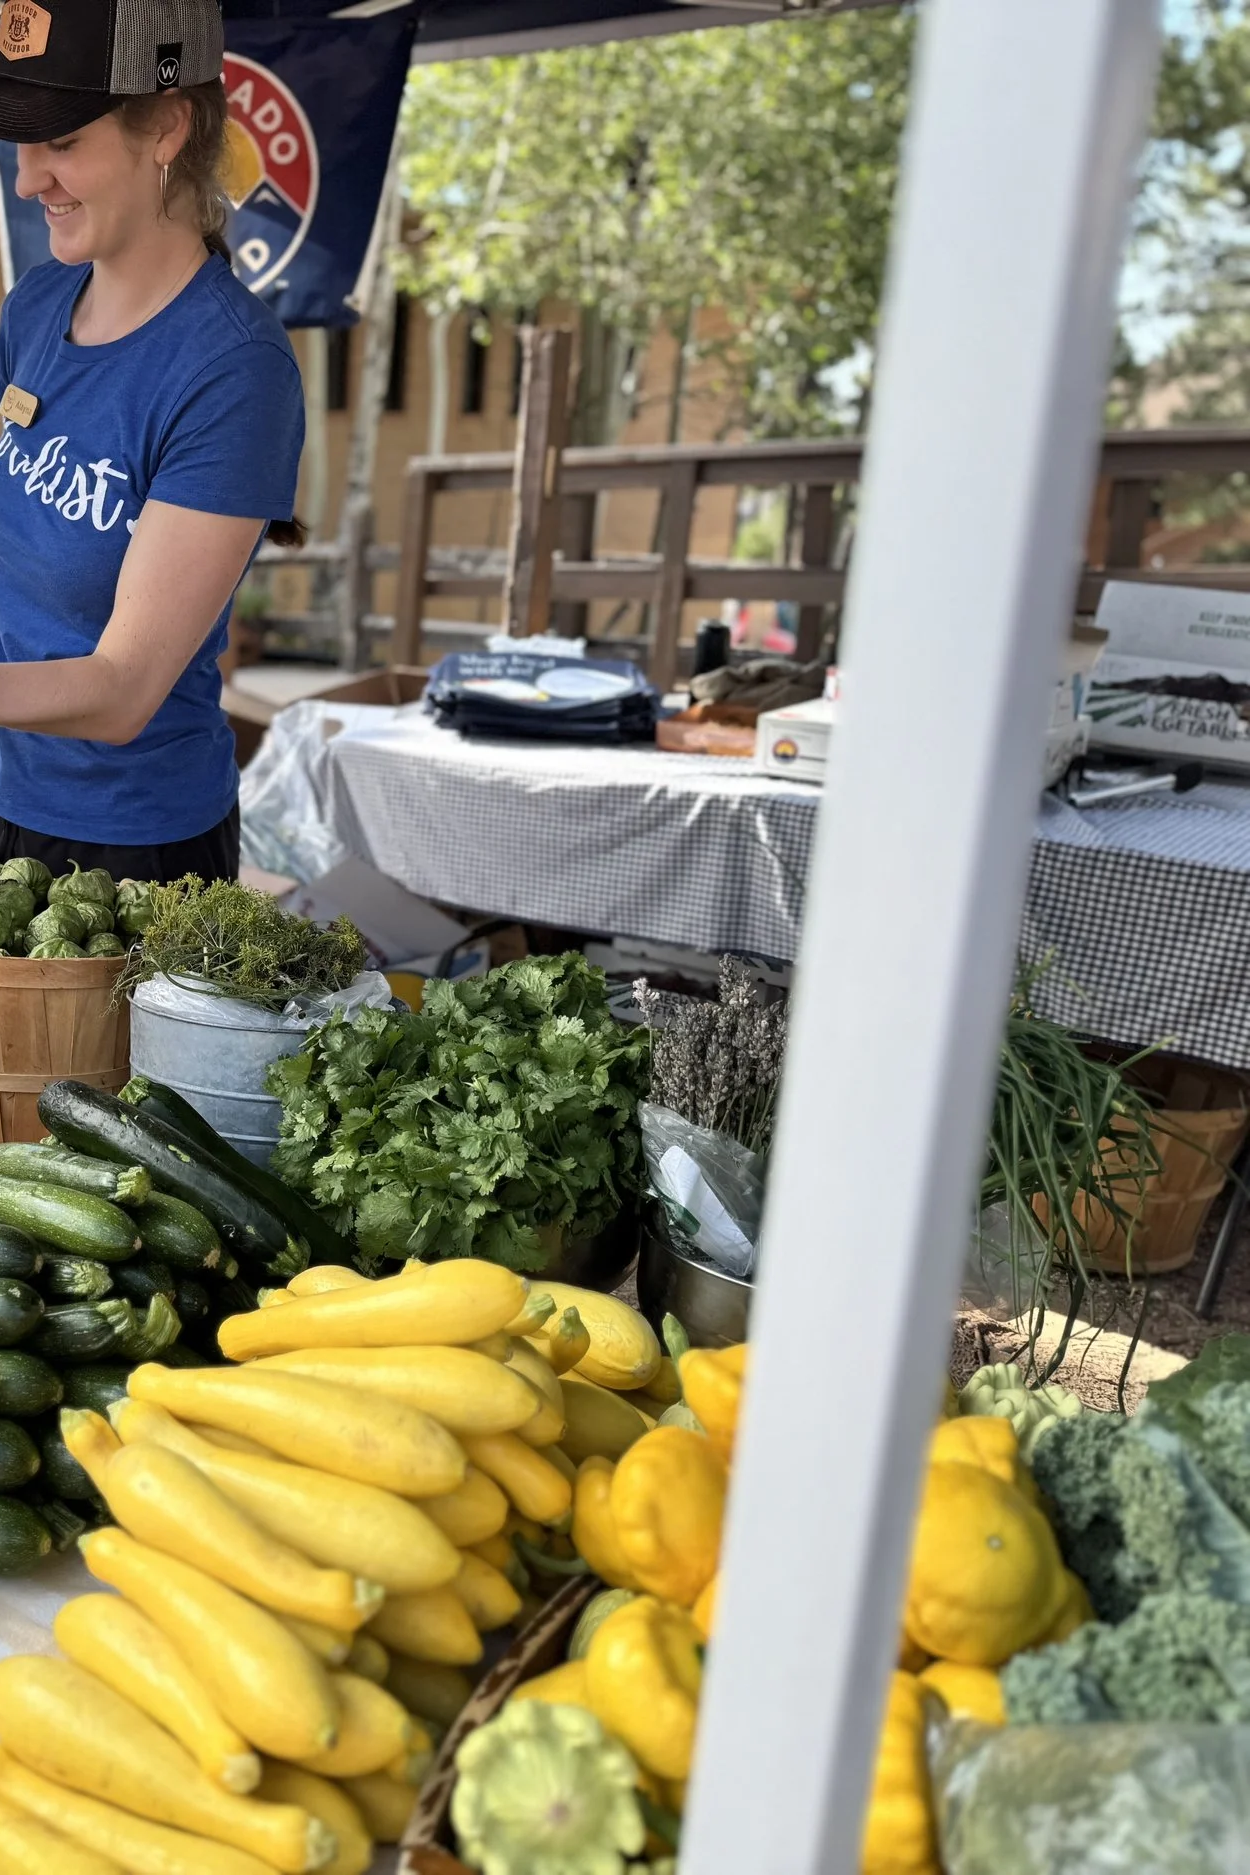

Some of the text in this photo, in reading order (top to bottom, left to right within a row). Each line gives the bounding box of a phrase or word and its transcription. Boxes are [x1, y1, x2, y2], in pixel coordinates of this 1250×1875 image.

[21, 5, 38, 19] YOUR
[3, 40, 30, 53] NEIGHBOR
[161, 65, 176, 79] W
[226, 79, 300, 165] ADO
[1170, 700, 1230, 721] FRESH
